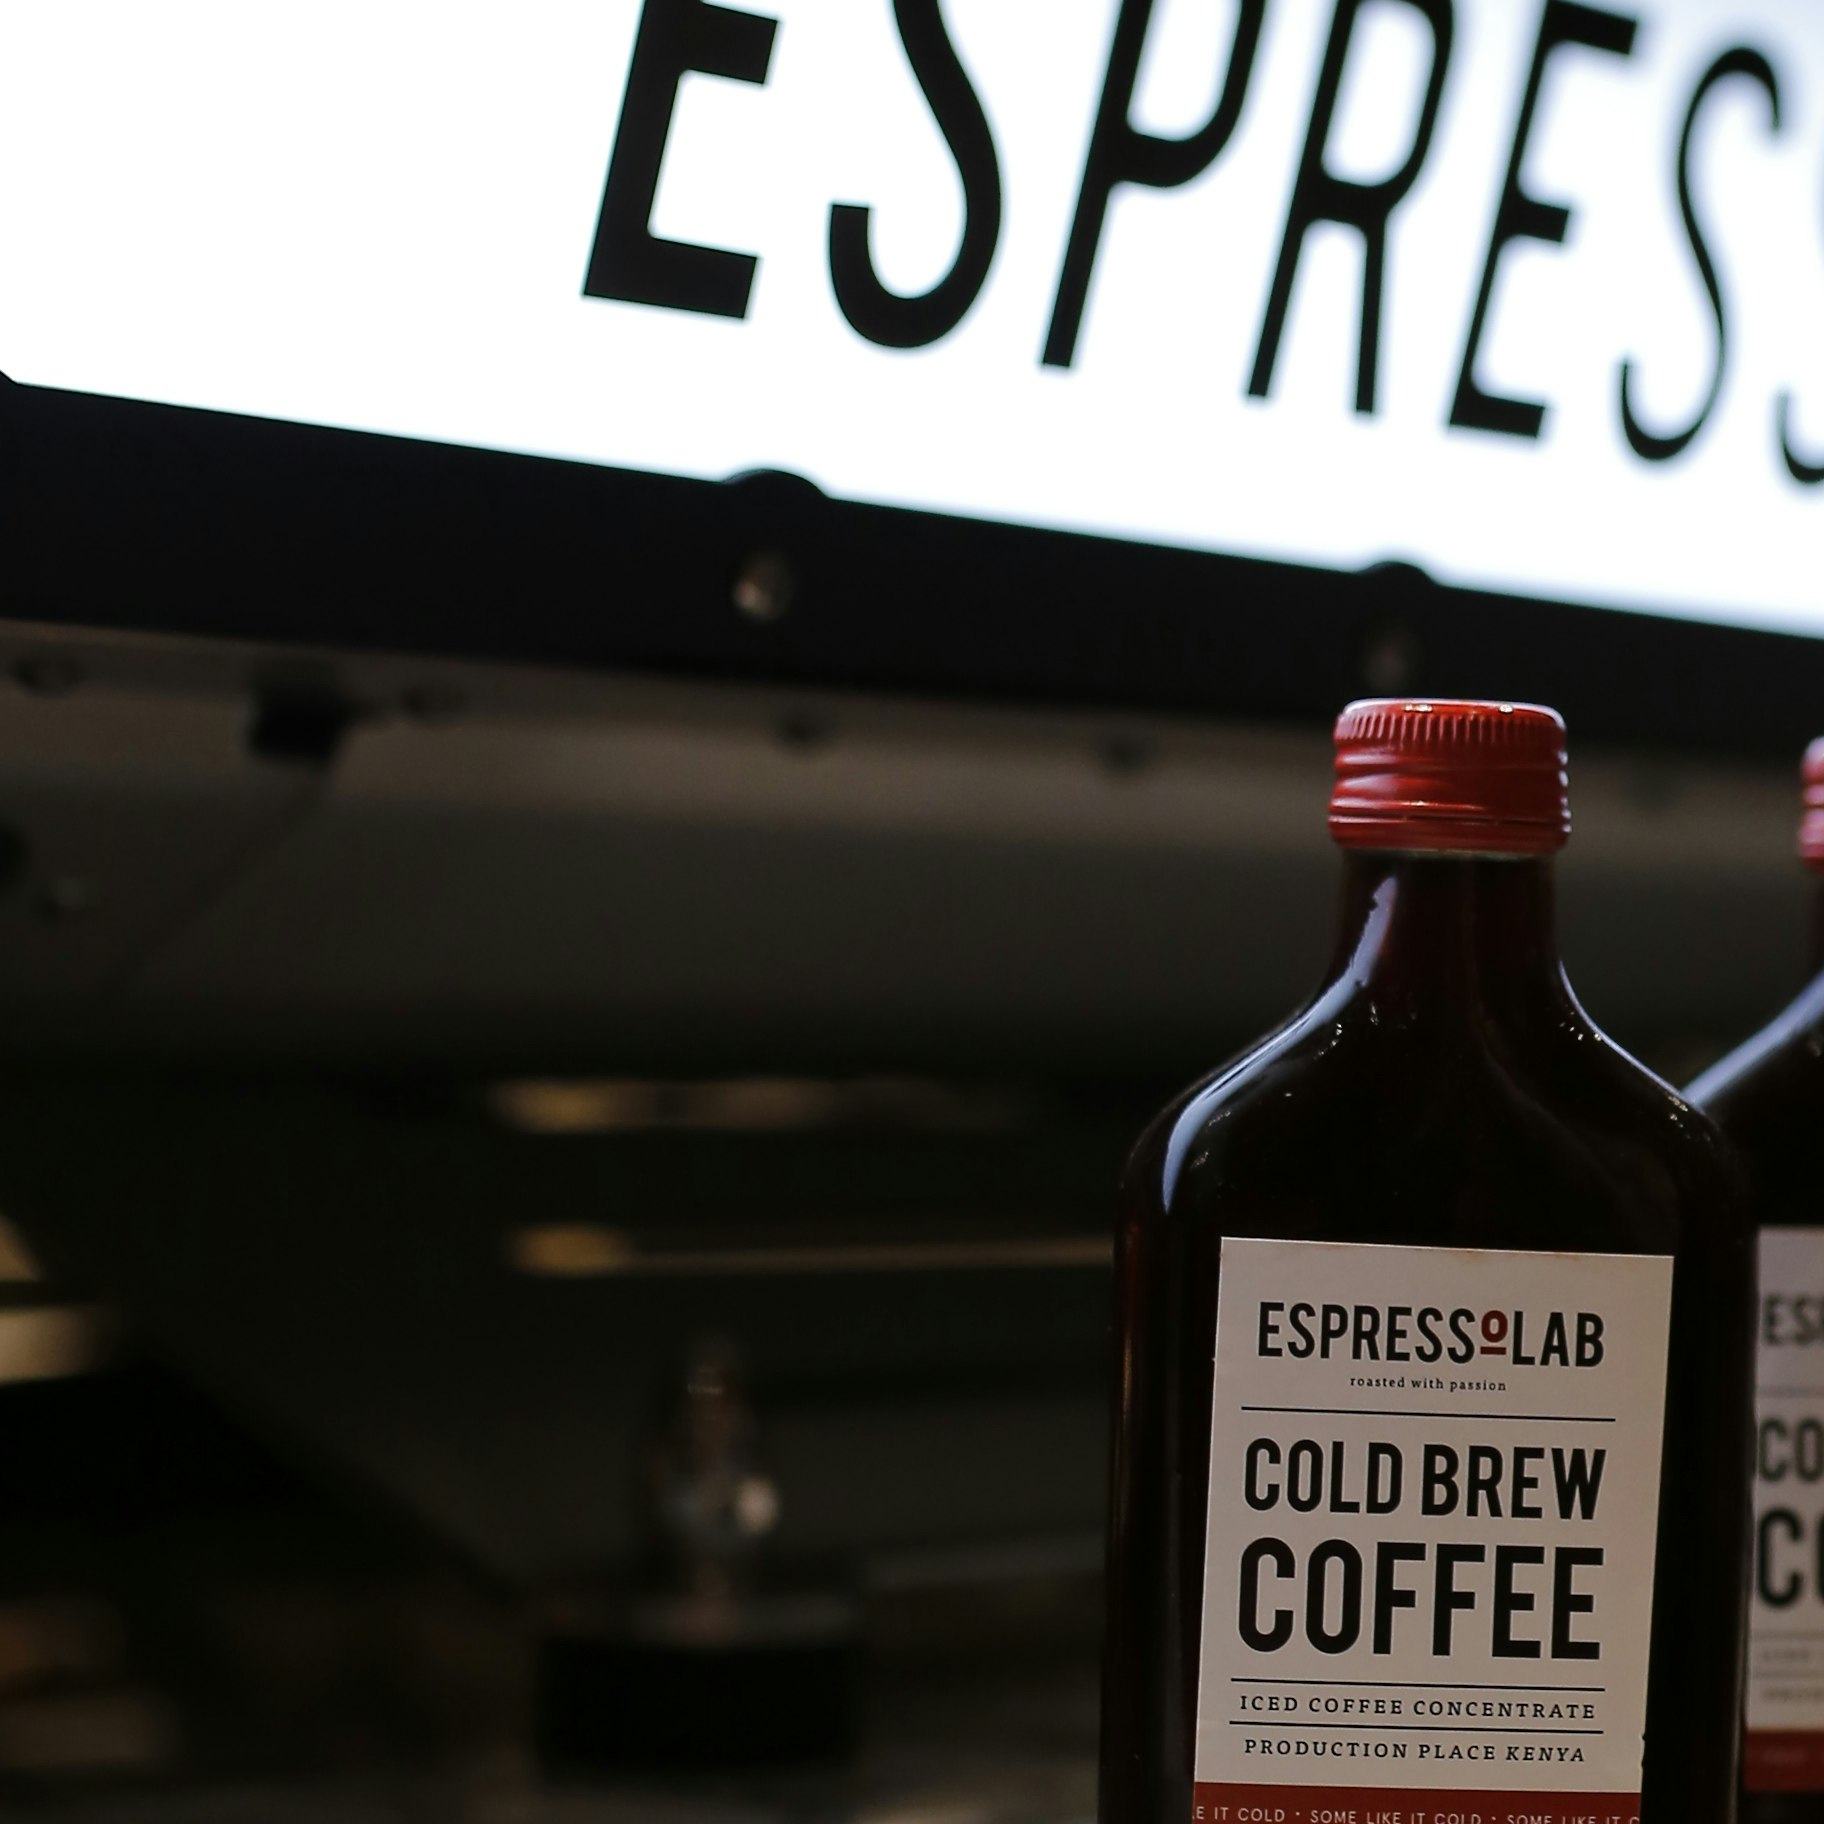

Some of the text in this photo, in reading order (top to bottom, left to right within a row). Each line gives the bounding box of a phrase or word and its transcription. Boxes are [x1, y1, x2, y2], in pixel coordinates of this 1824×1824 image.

[1350, 1377, 1507, 1393] roasted with passion
[1244, 1437, 1607, 1521] COLD BREW
[1238, 1536, 1605, 1660] COFFEE
[1240, 1695, 1595, 1719] ICED COFFEE CONCENTRATE
[1244, 1739, 1585, 1762] PRODUCTION PLACE KENYA
[1214, 1806, 1230, 1821] IT
[1237, 1807, 1286, 1823] COLD
[1310, 1809, 1357, 1824] SOME
